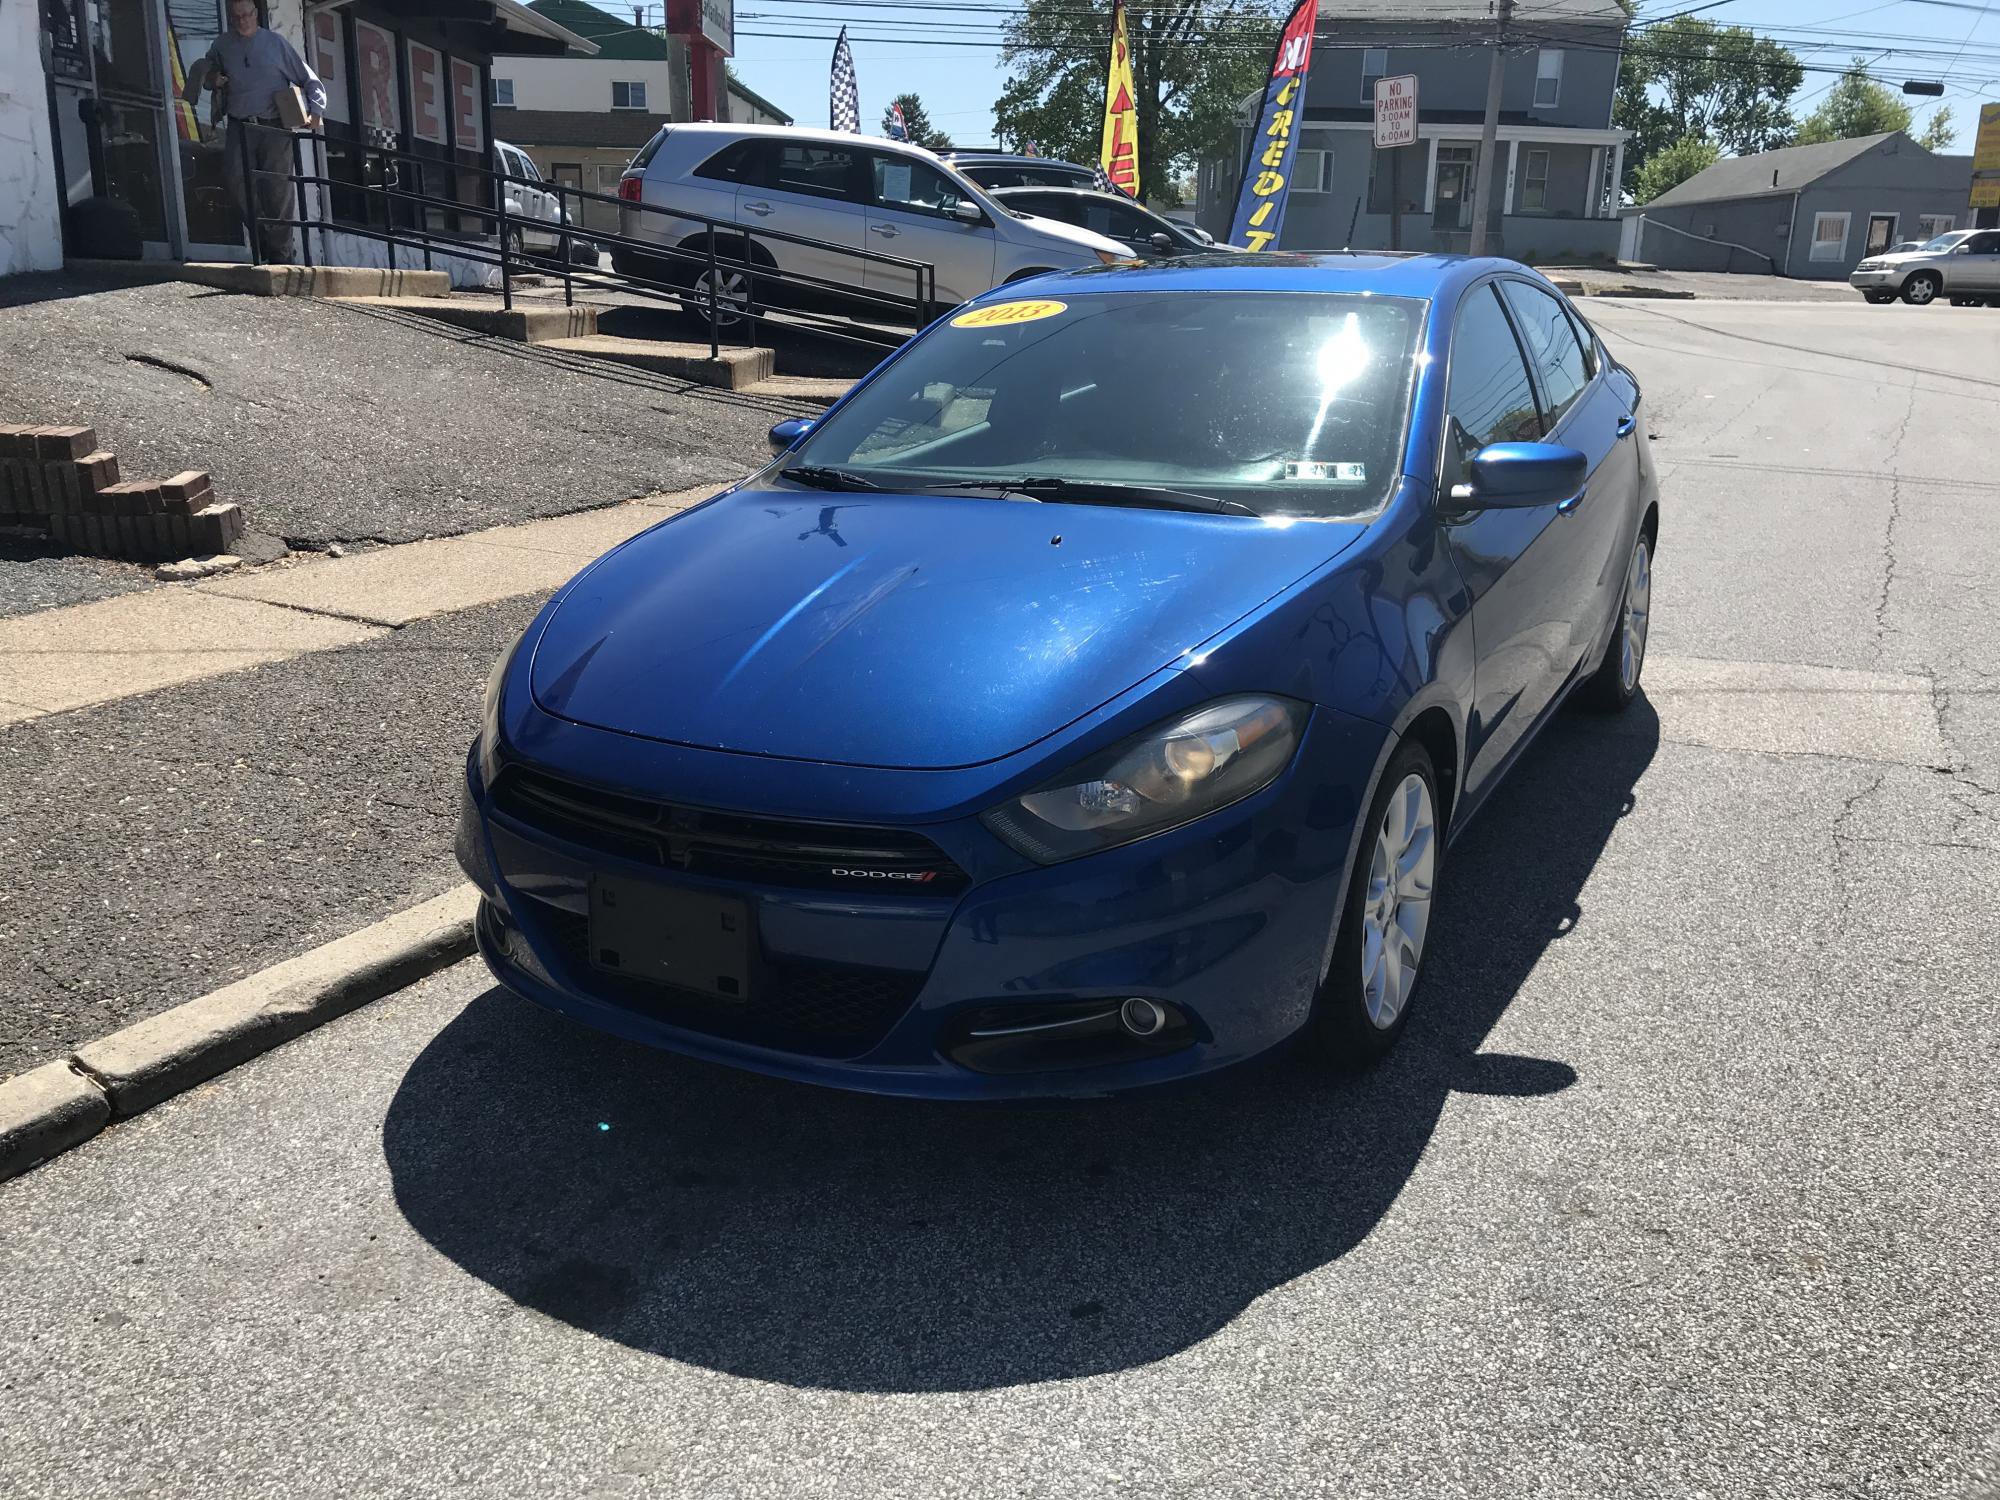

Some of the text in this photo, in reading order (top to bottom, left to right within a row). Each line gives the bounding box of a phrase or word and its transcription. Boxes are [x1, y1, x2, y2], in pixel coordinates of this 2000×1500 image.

[1389, 82, 1402, 97] NO
[1378, 96, 1413, 112] PARKING
[1391, 121, 1401, 131] TO
[1245, 77, 1300, 252] CREDIT
[965, 303, 1051, 325] 2013
[831, 868, 923, 880] DODGE
